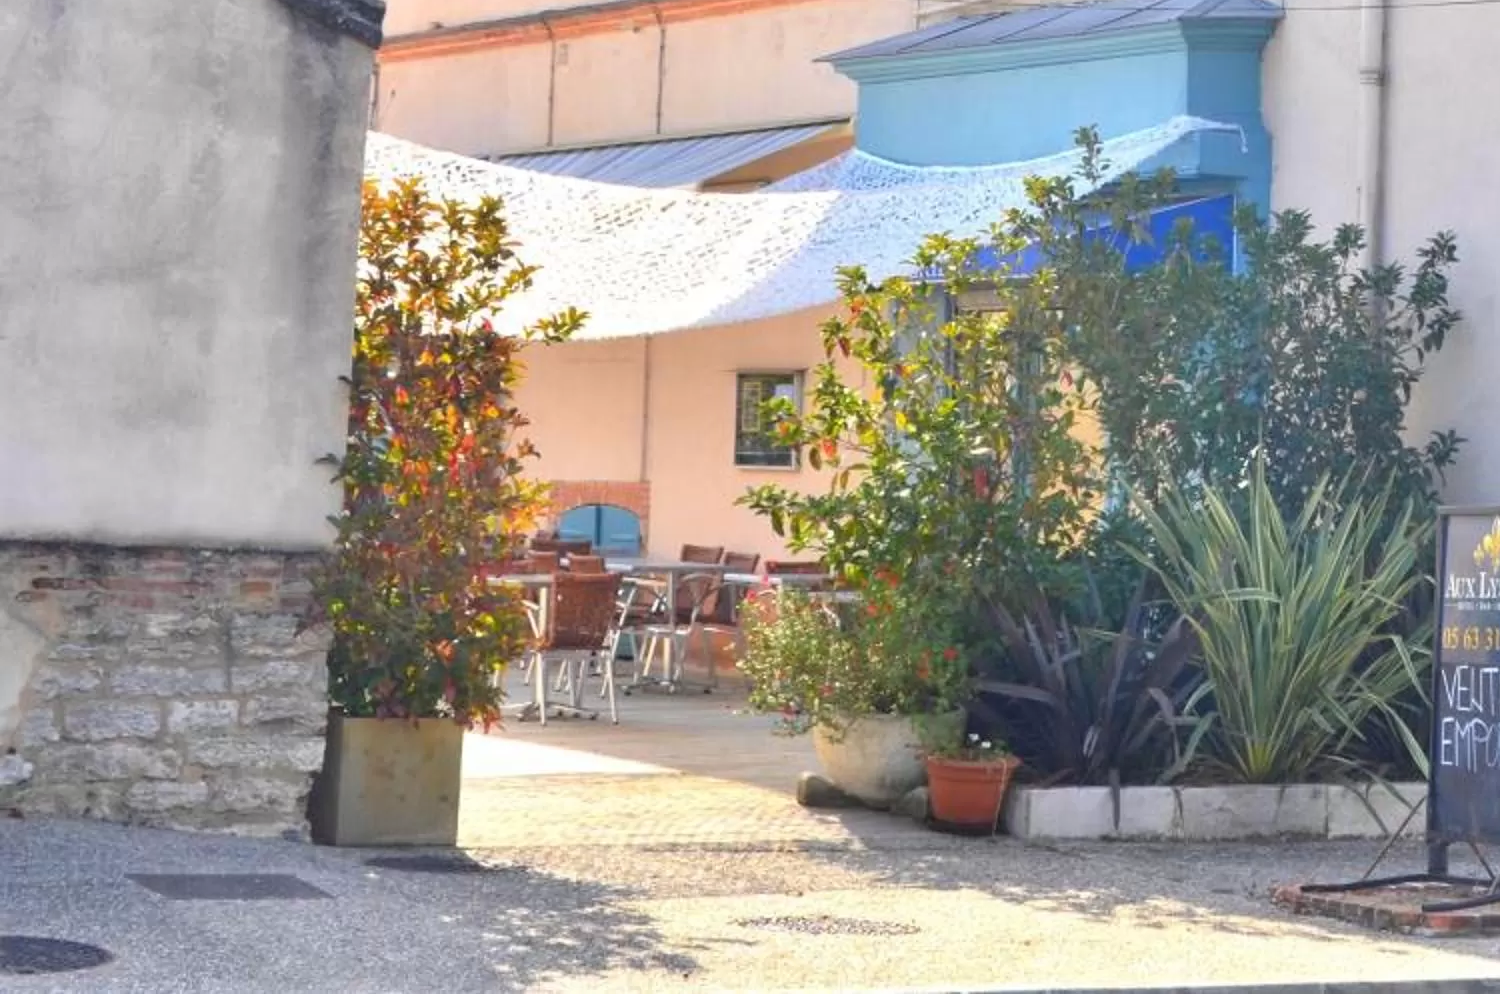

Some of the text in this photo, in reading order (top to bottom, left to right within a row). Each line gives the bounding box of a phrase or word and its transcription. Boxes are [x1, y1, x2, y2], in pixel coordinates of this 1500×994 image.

[1445, 574, 1475, 599] AUX
[1443, 626, 1459, 649] 05
[1464, 627, 1479, 650] 63
[1485, 627, 1500, 651] 31
